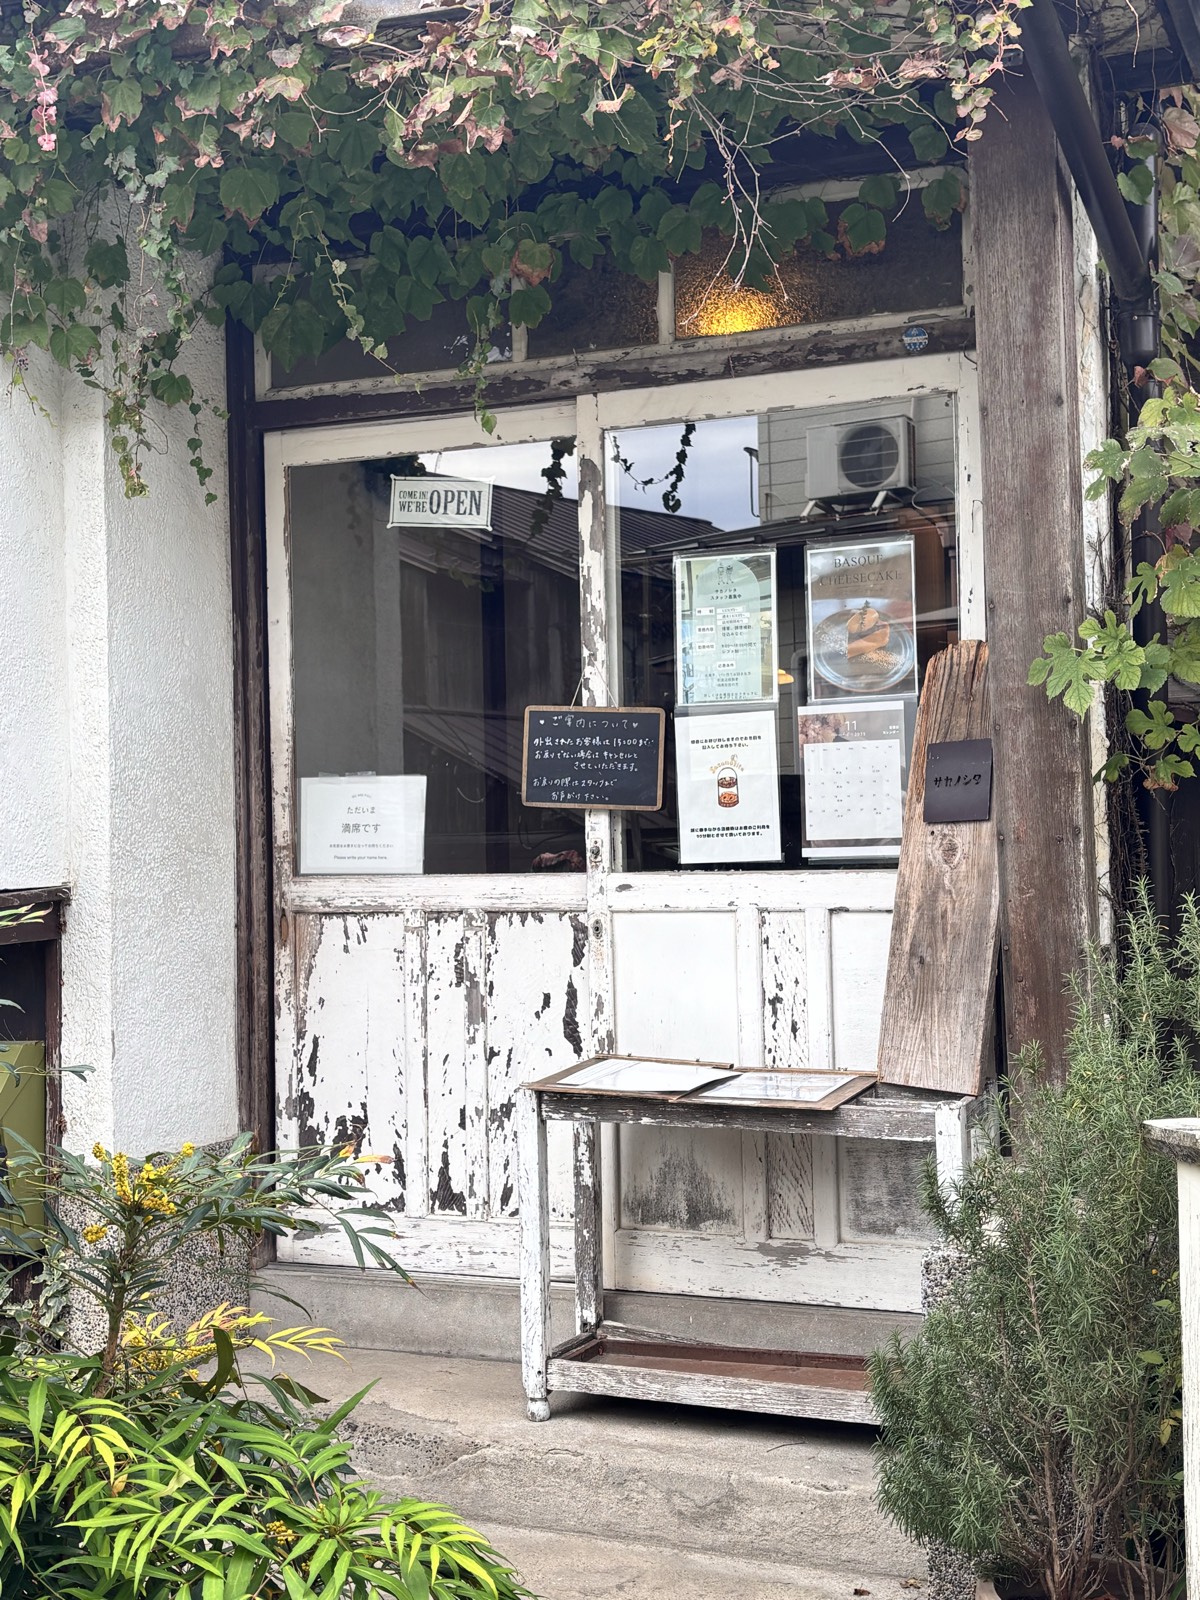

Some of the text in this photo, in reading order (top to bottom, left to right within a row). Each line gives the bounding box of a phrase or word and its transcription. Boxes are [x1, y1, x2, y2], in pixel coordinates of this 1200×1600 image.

[399, 491, 418, 500] COME
[399, 501, 428, 513] WE'RE
[429, 489, 484, 516] OPEN
[834, 554, 884, 568] BASQUE
[845, 720, 857, 731] 11
[933, 774, 982, 788] サカノシタ
[347, 806, 376, 814] ただいま
[341, 823, 381, 834] 満席です
